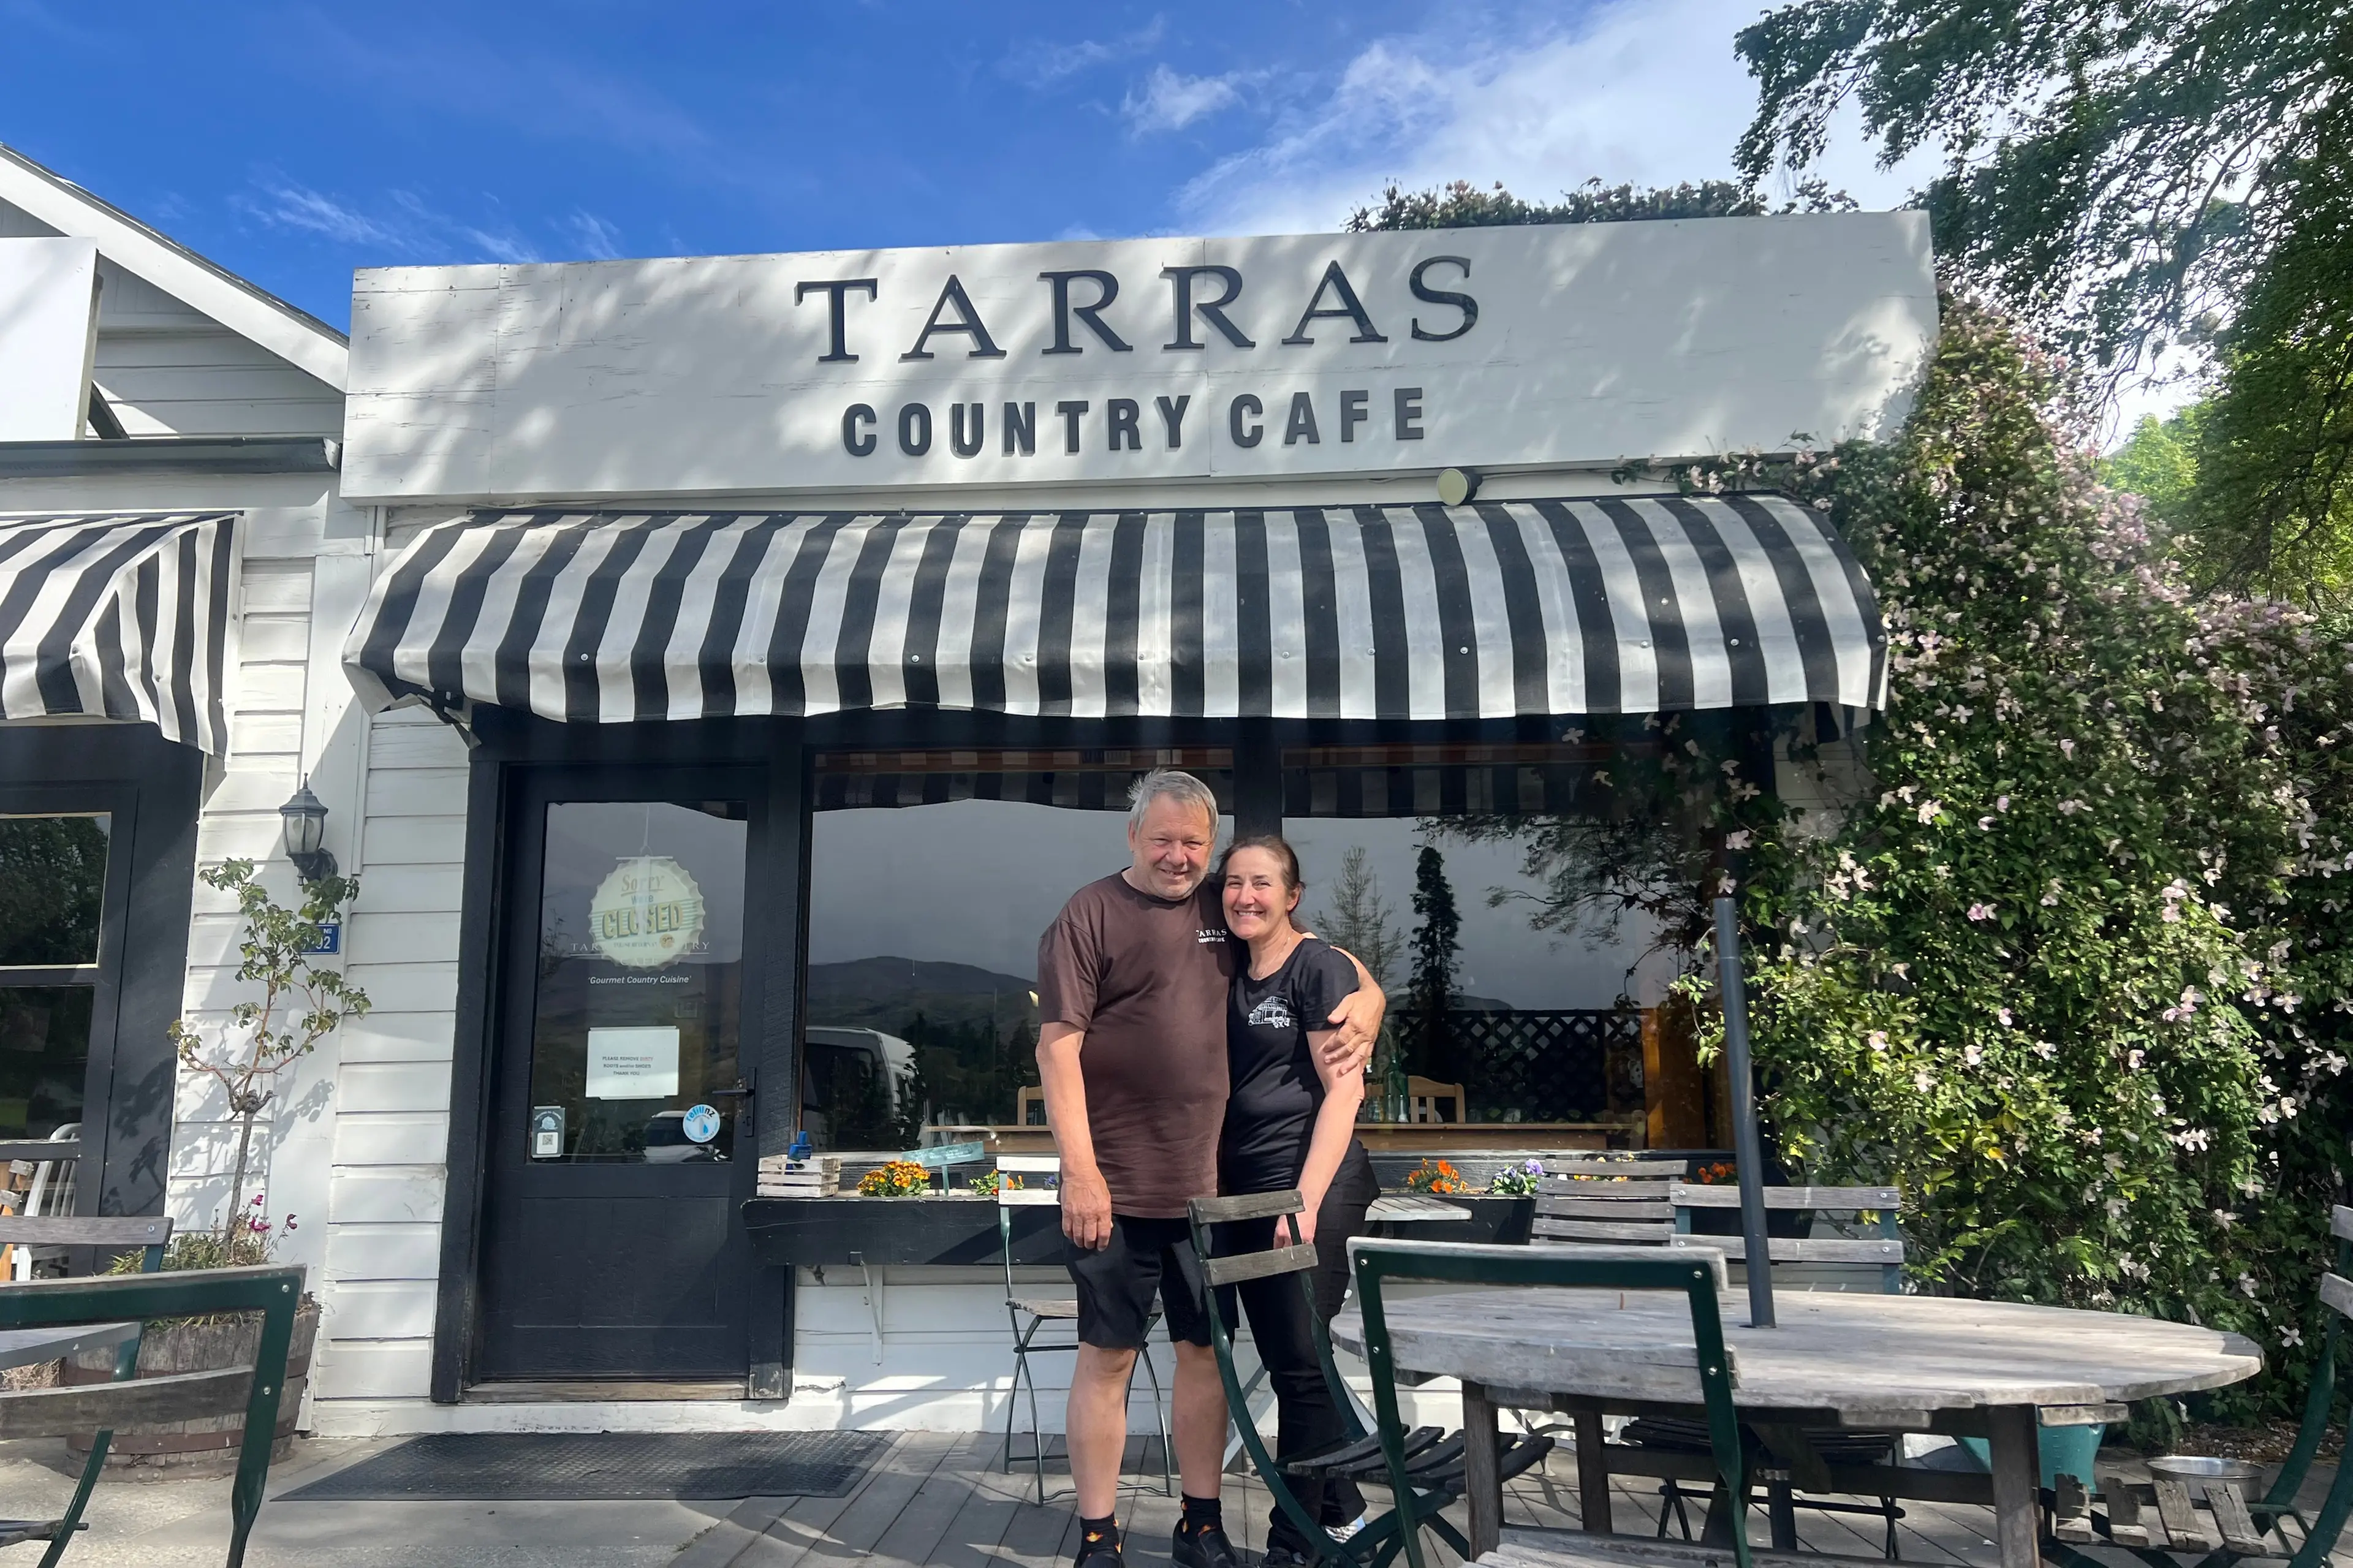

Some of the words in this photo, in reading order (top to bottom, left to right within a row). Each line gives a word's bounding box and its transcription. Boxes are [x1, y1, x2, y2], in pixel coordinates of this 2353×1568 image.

[795, 255, 1479, 363] TARRAS
[843, 395, 1190, 457] COUNTRY
[1230, 387, 1424, 449] CAFE
[602, 901, 683, 939] CLOSED
[627, 976, 658, 985] Country
